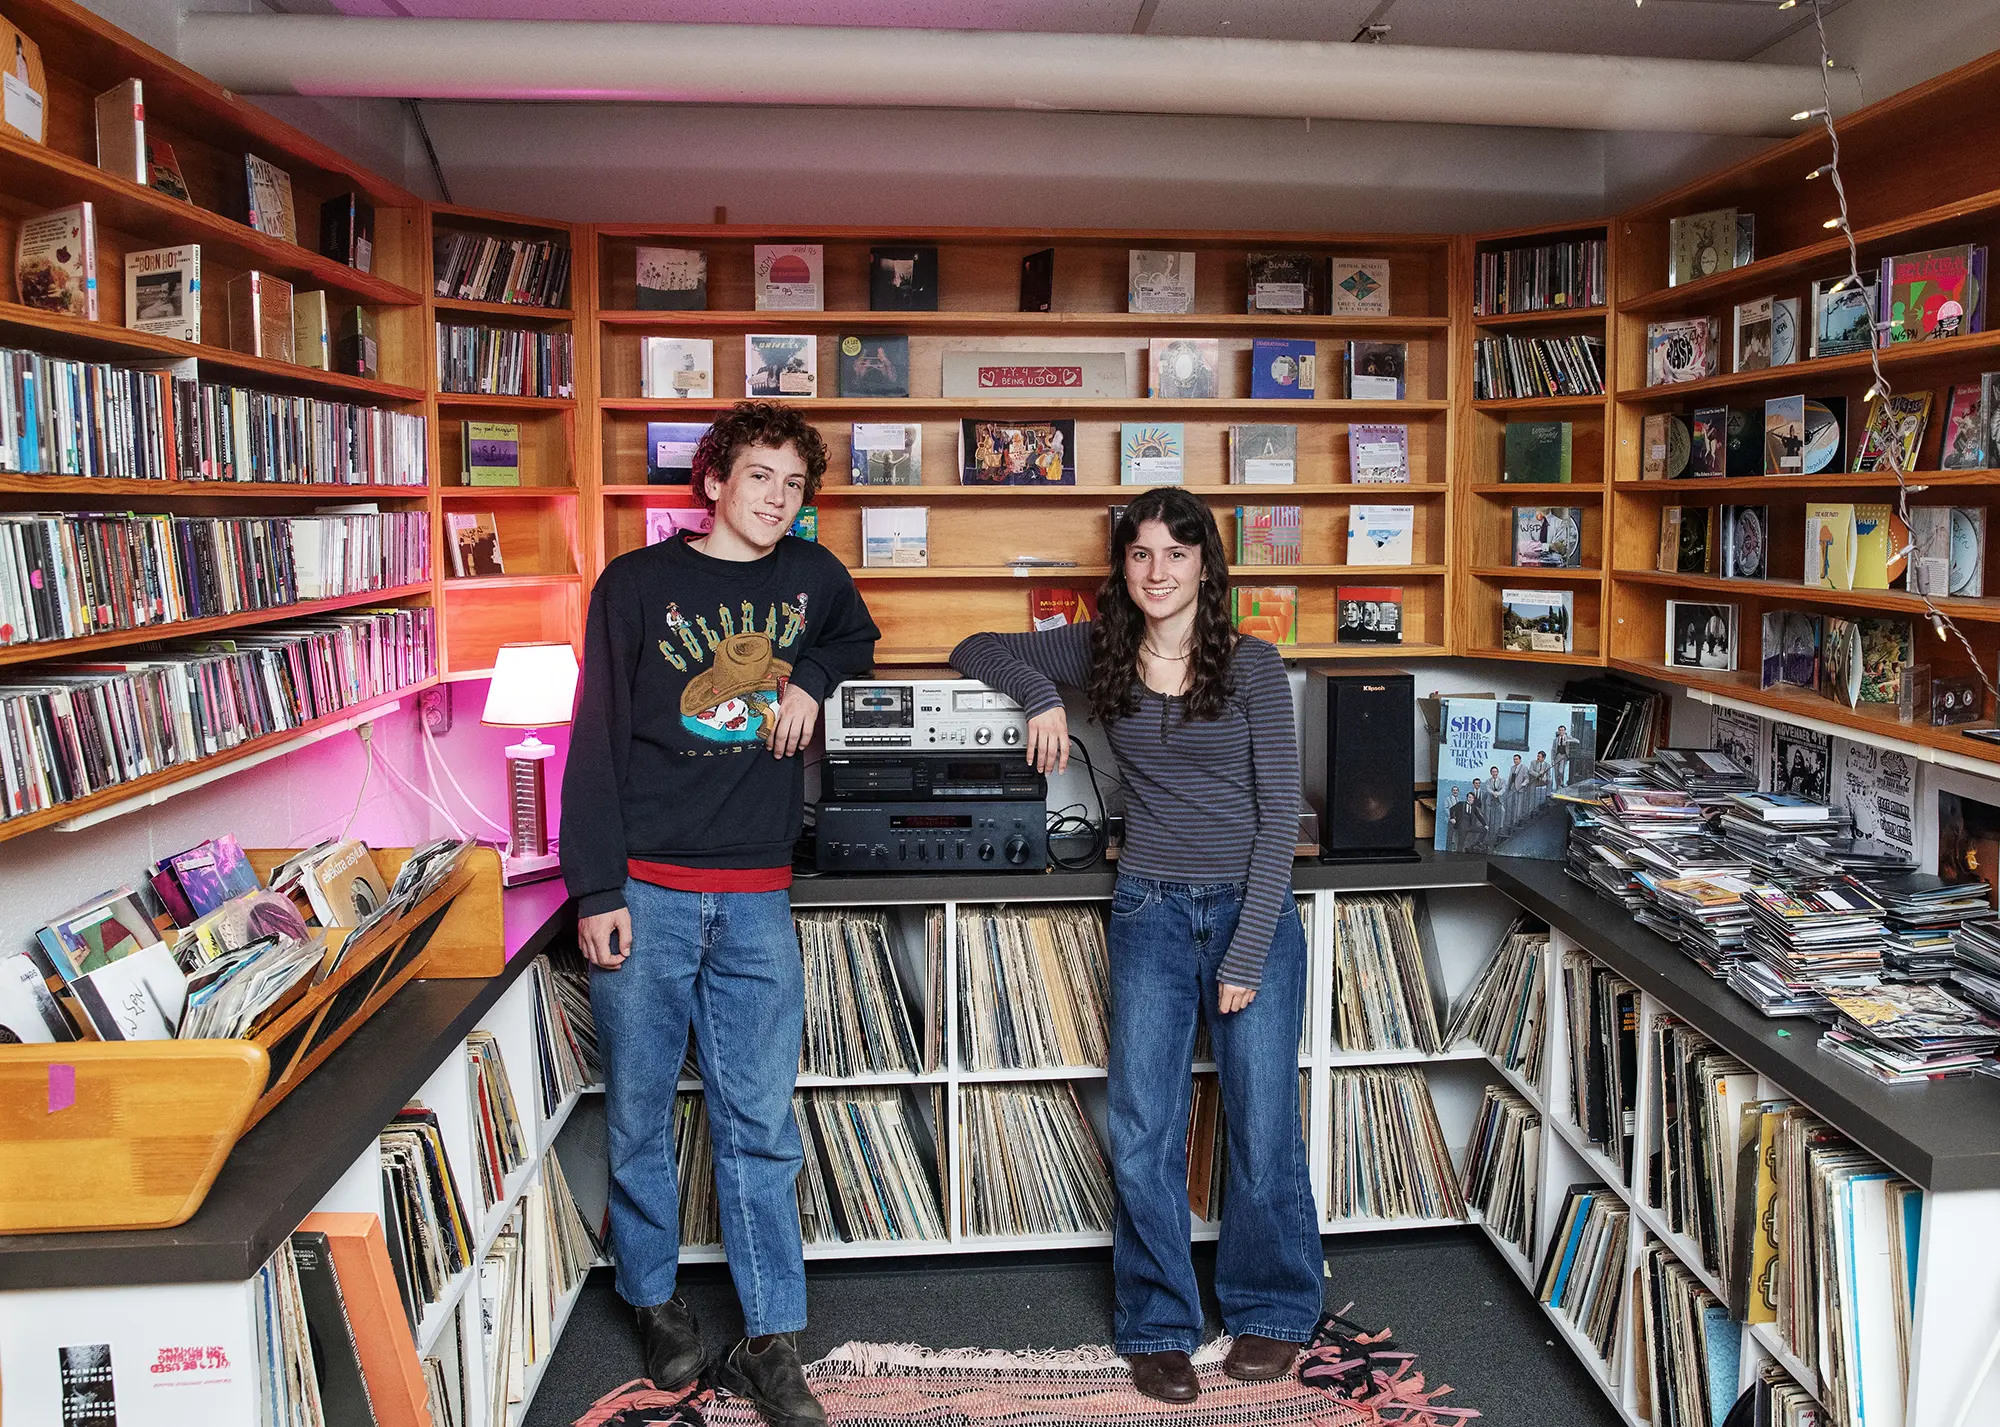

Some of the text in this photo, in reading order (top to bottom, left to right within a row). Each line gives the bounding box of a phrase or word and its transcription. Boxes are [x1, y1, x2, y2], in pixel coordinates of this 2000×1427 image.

[1891, 328, 1918, 342] WSPN
[1775, 722, 1810, 741] NOVEMBER
[1811, 729, 1827, 746] 4TH
[1451, 739, 1490, 750] ALPERT
[1450, 749, 1488, 760] TIJUANA
[1455, 758, 1483, 769] BRASS
[321, 858, 348, 884] elektra
